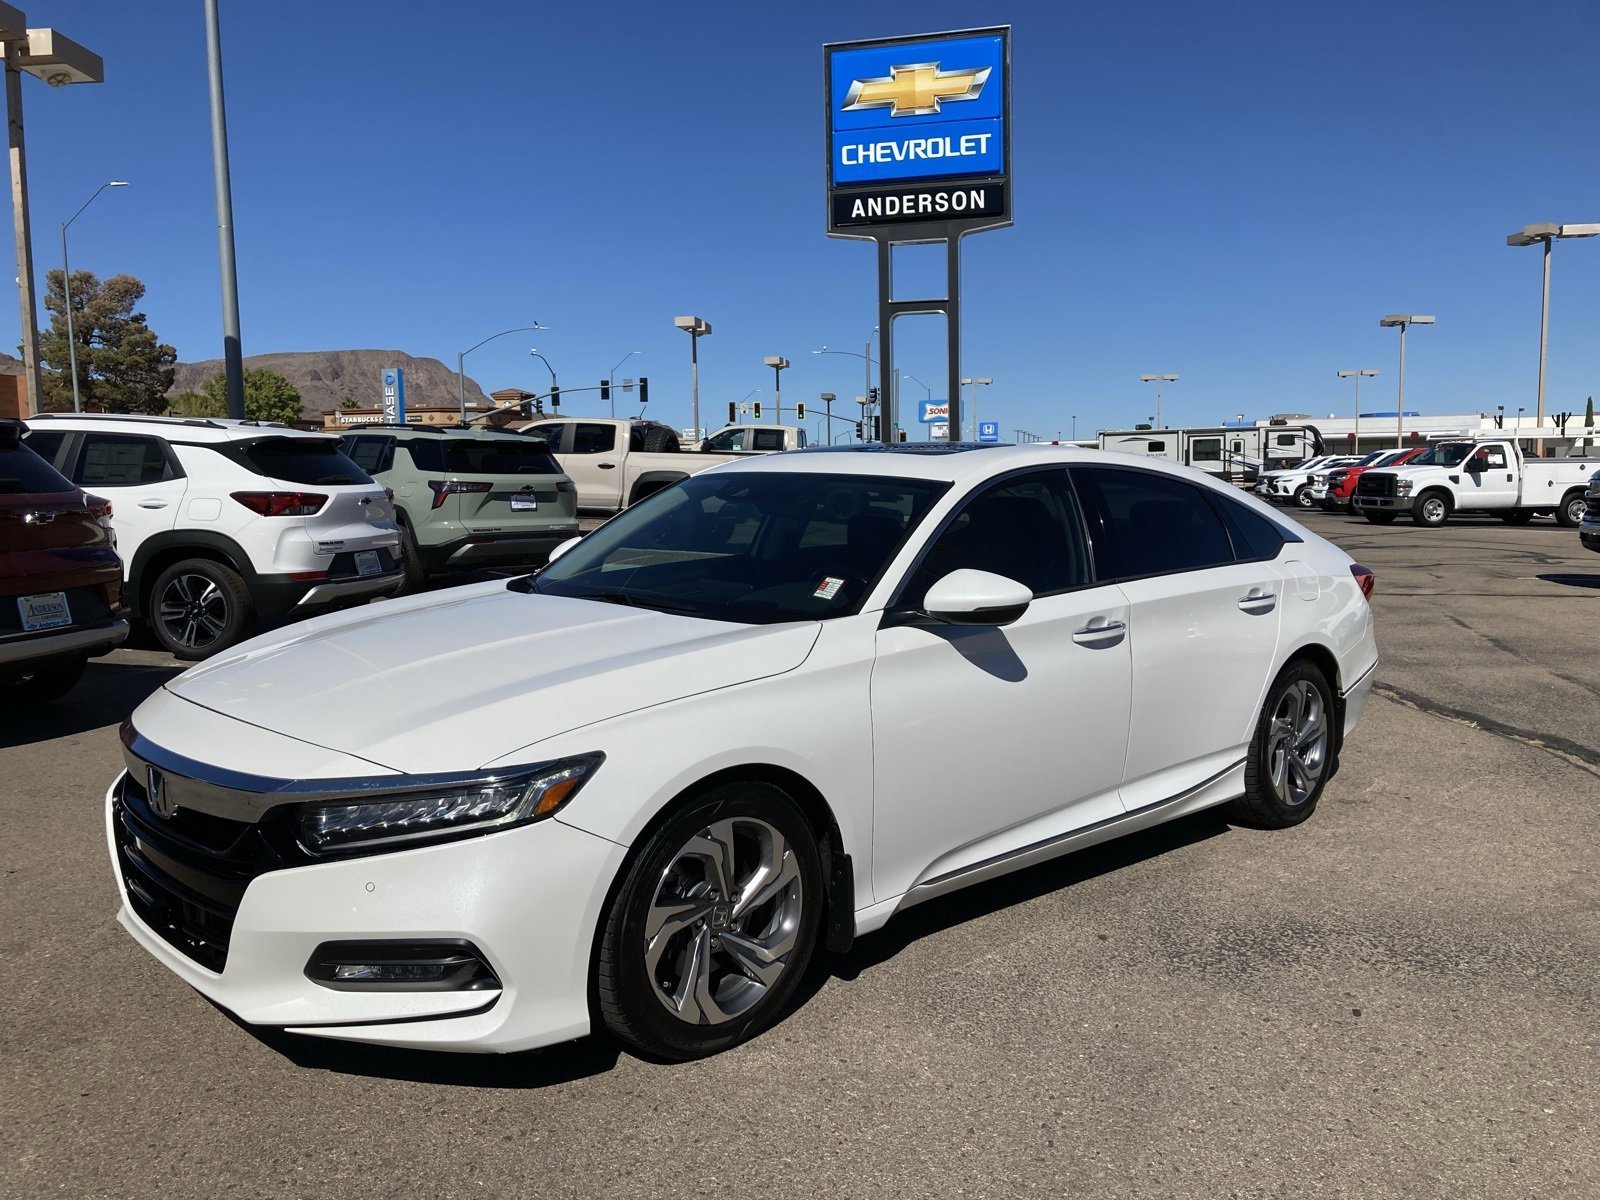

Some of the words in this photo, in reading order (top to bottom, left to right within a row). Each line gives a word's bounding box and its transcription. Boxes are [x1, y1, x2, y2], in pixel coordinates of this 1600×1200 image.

[841, 133, 992, 165] CHEVROLET
[851, 189, 986, 218] ANDERSON
[385, 387, 396, 428] HASE
[928, 407, 950, 415] SONI
